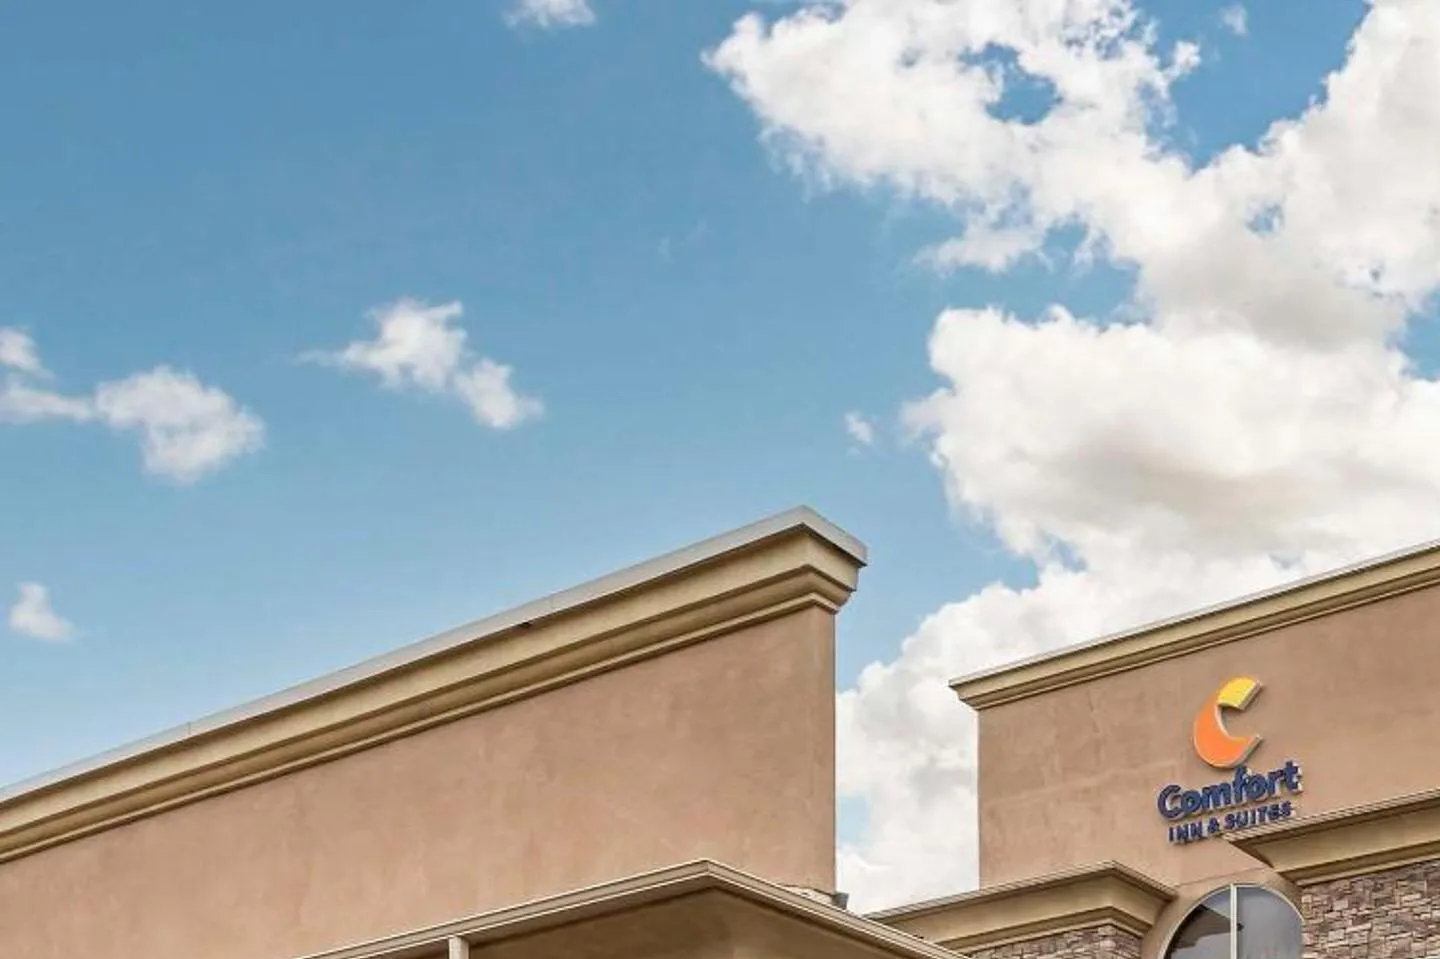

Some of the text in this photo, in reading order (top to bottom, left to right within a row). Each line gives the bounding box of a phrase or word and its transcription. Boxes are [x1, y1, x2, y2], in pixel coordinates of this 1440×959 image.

[1158, 761, 1302, 818] Comfort
[1168, 801, 1293, 843] INN & SUITES
